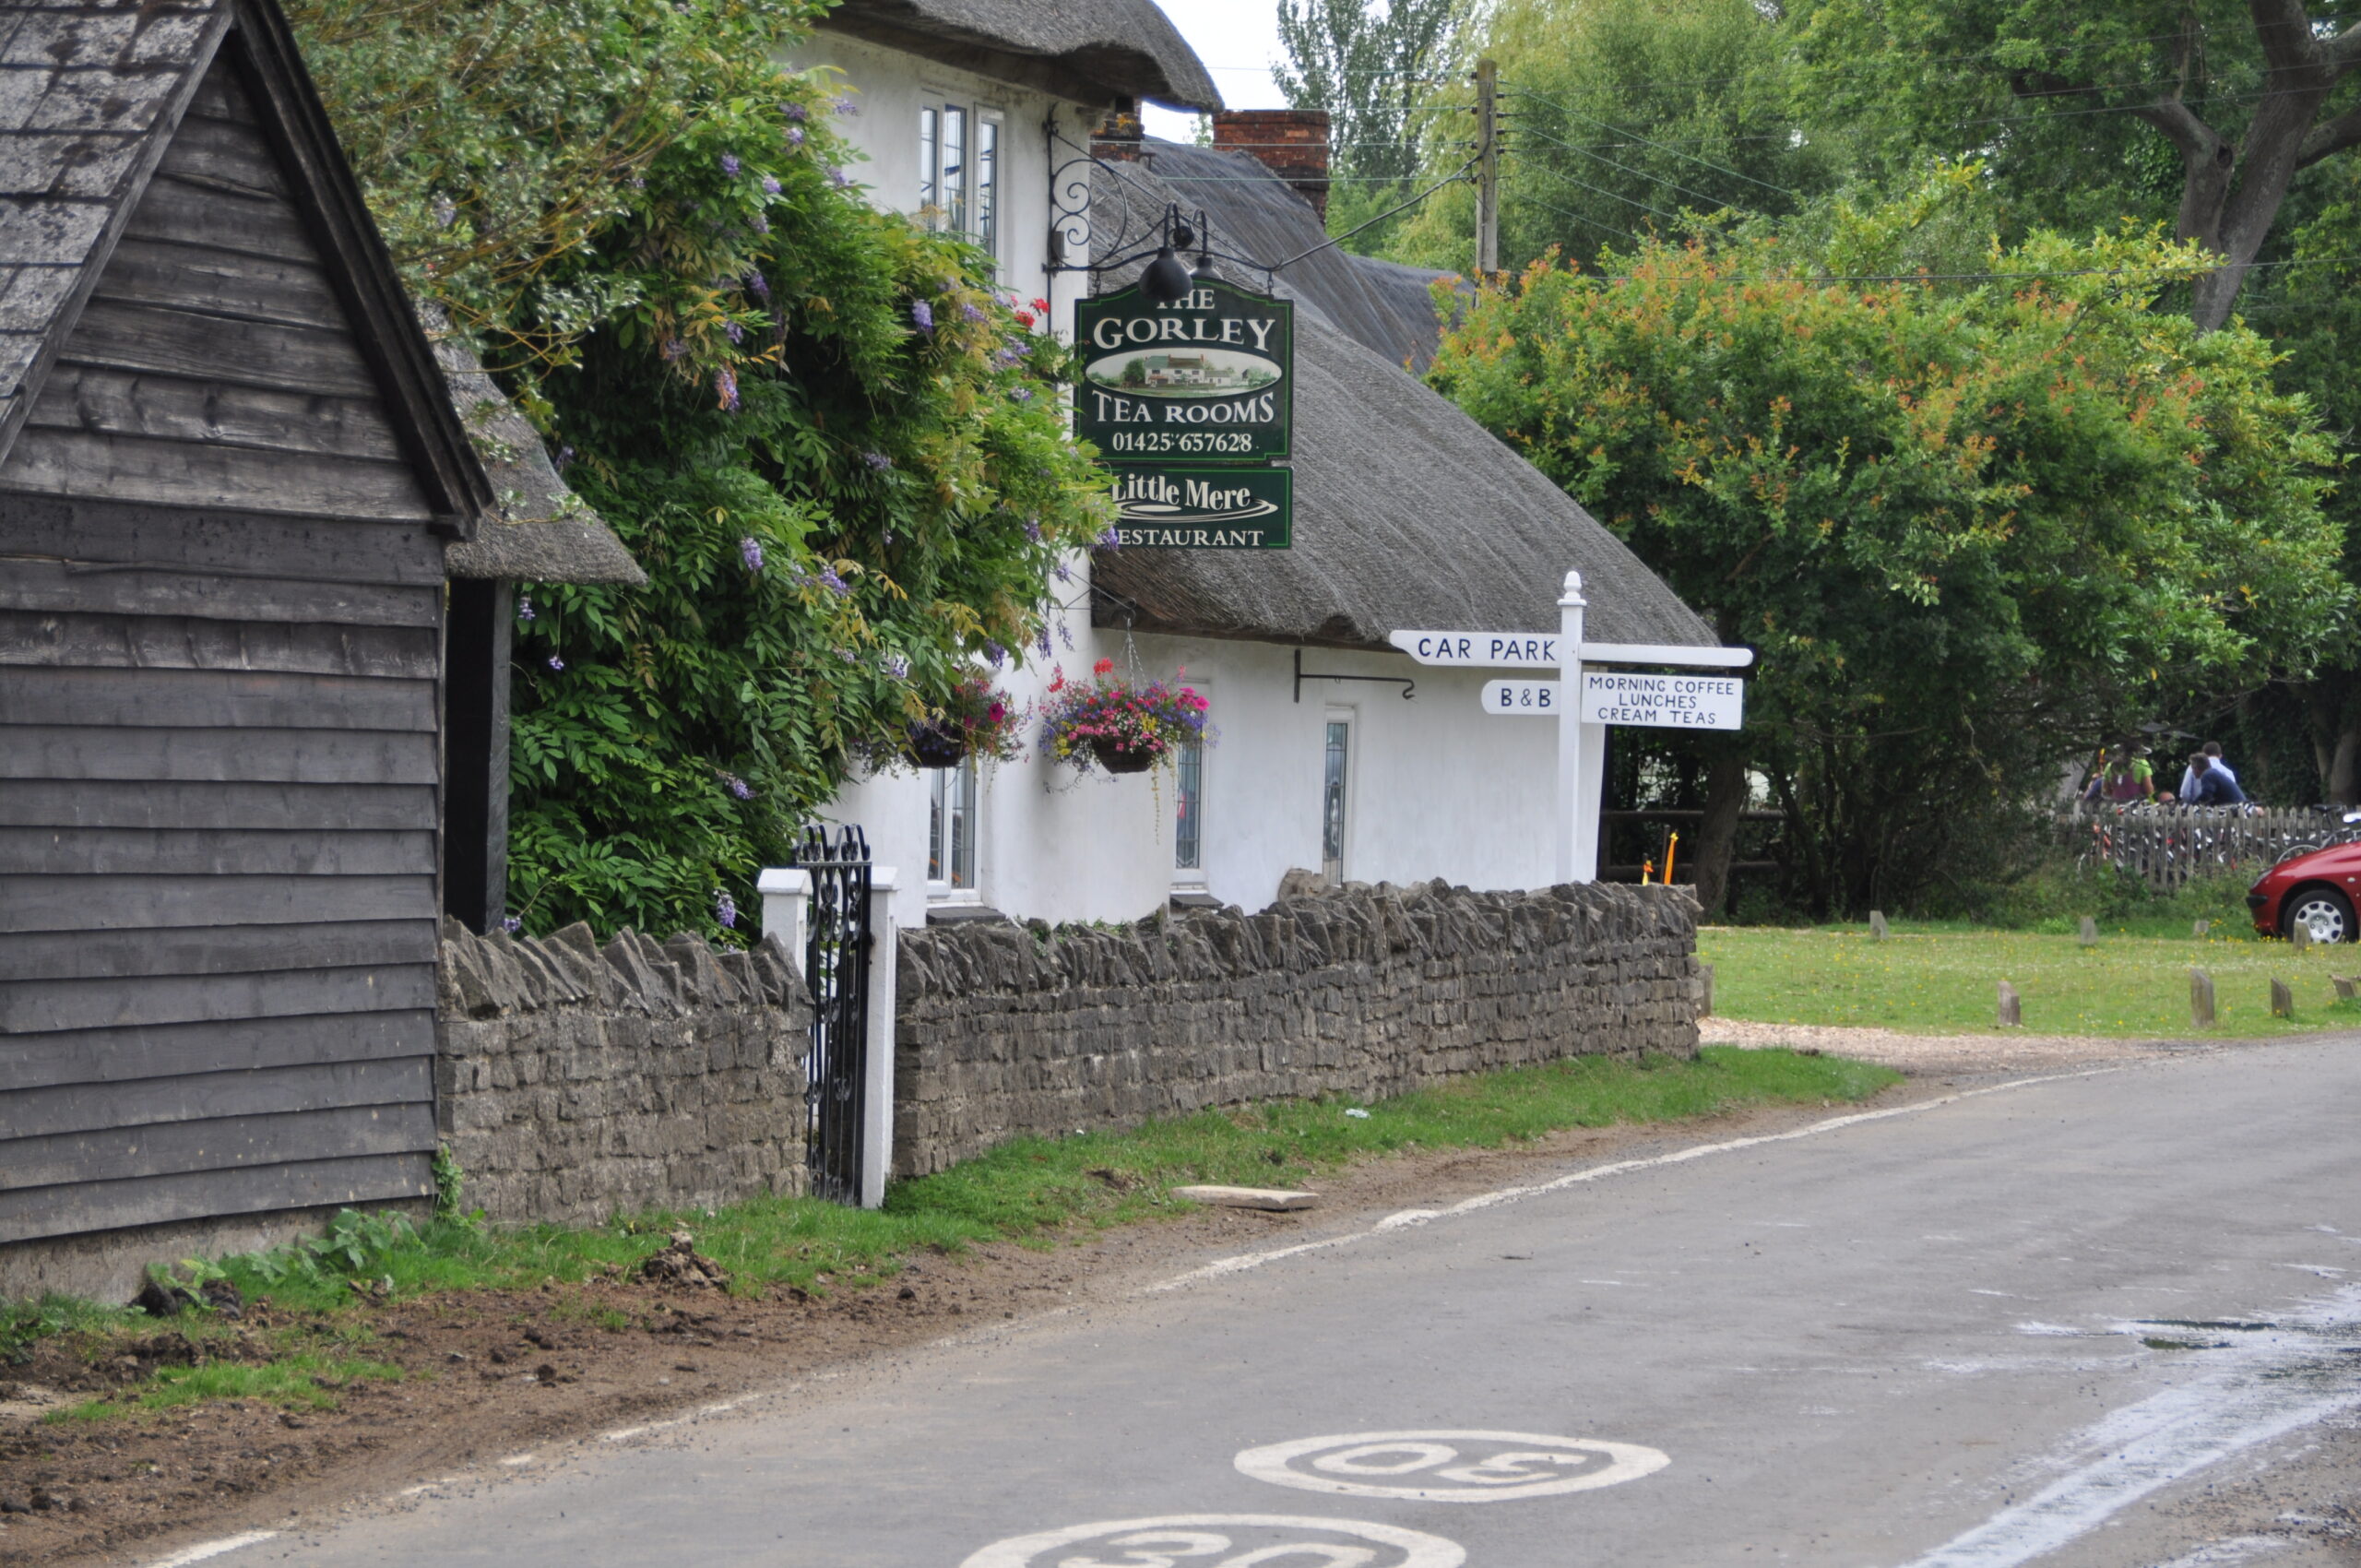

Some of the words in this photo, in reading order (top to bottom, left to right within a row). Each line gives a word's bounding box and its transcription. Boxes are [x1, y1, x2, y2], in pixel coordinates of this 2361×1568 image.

[1093, 317, 1275, 352] GORLEY
[1092, 389, 1153, 422] TEA
[1165, 392, 1275, 423] ROOMS
[1112, 432, 1171, 451] 01425
[1180, 433, 1252, 452] 657628
[1111, 473, 1180, 505] Little
[1185, 479, 1251, 511] Mere
[1097, 529, 1264, 546] ESTAURANT
[1418, 637, 1471, 659] CAR
[1490, 639, 1556, 661] PARK
[1589, 676, 1666, 693] MORNING
[1674, 681, 1735, 695] COFFEE
[1619, 693, 1697, 709] LUNCHES
[1597, 707, 1657, 722] CREAM
[1669, 710, 1716, 725] TEAS
